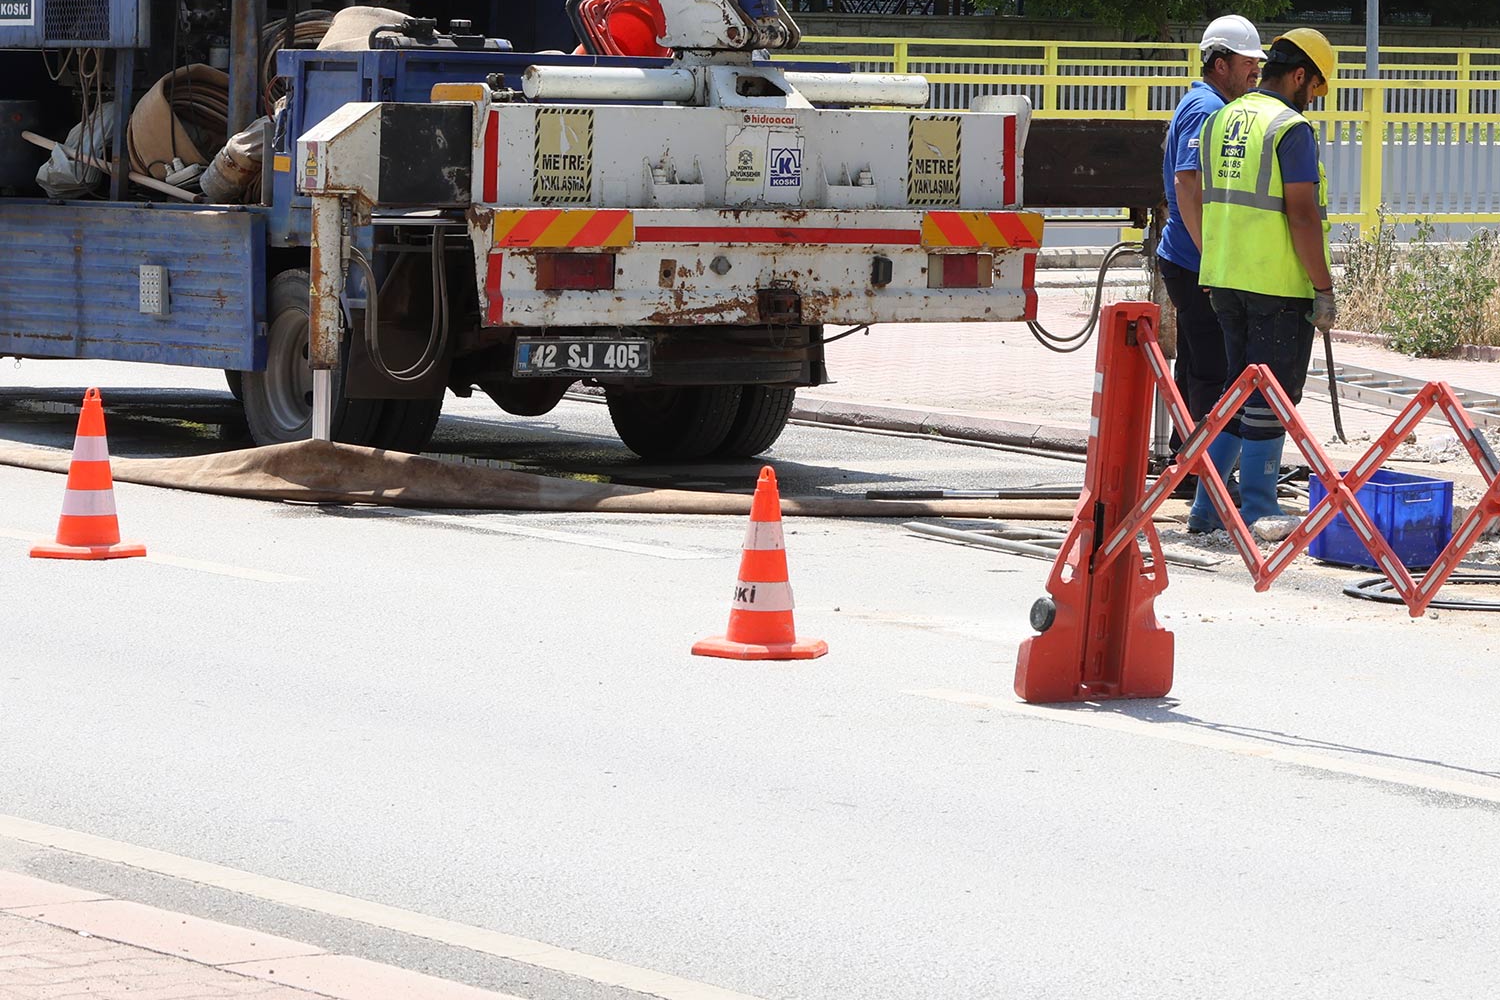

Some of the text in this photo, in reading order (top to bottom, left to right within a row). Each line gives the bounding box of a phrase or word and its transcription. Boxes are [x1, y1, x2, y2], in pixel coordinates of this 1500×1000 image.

[751, 114, 795, 125] hidroacar
[542, 153, 585, 171] METRE
[915, 159, 954, 175] METRE
[913, 179, 954, 198] YAKLAŞMA
[531, 344, 558, 368] 42
[567, 343, 594, 369] SJ
[603, 344, 640, 369] 405
